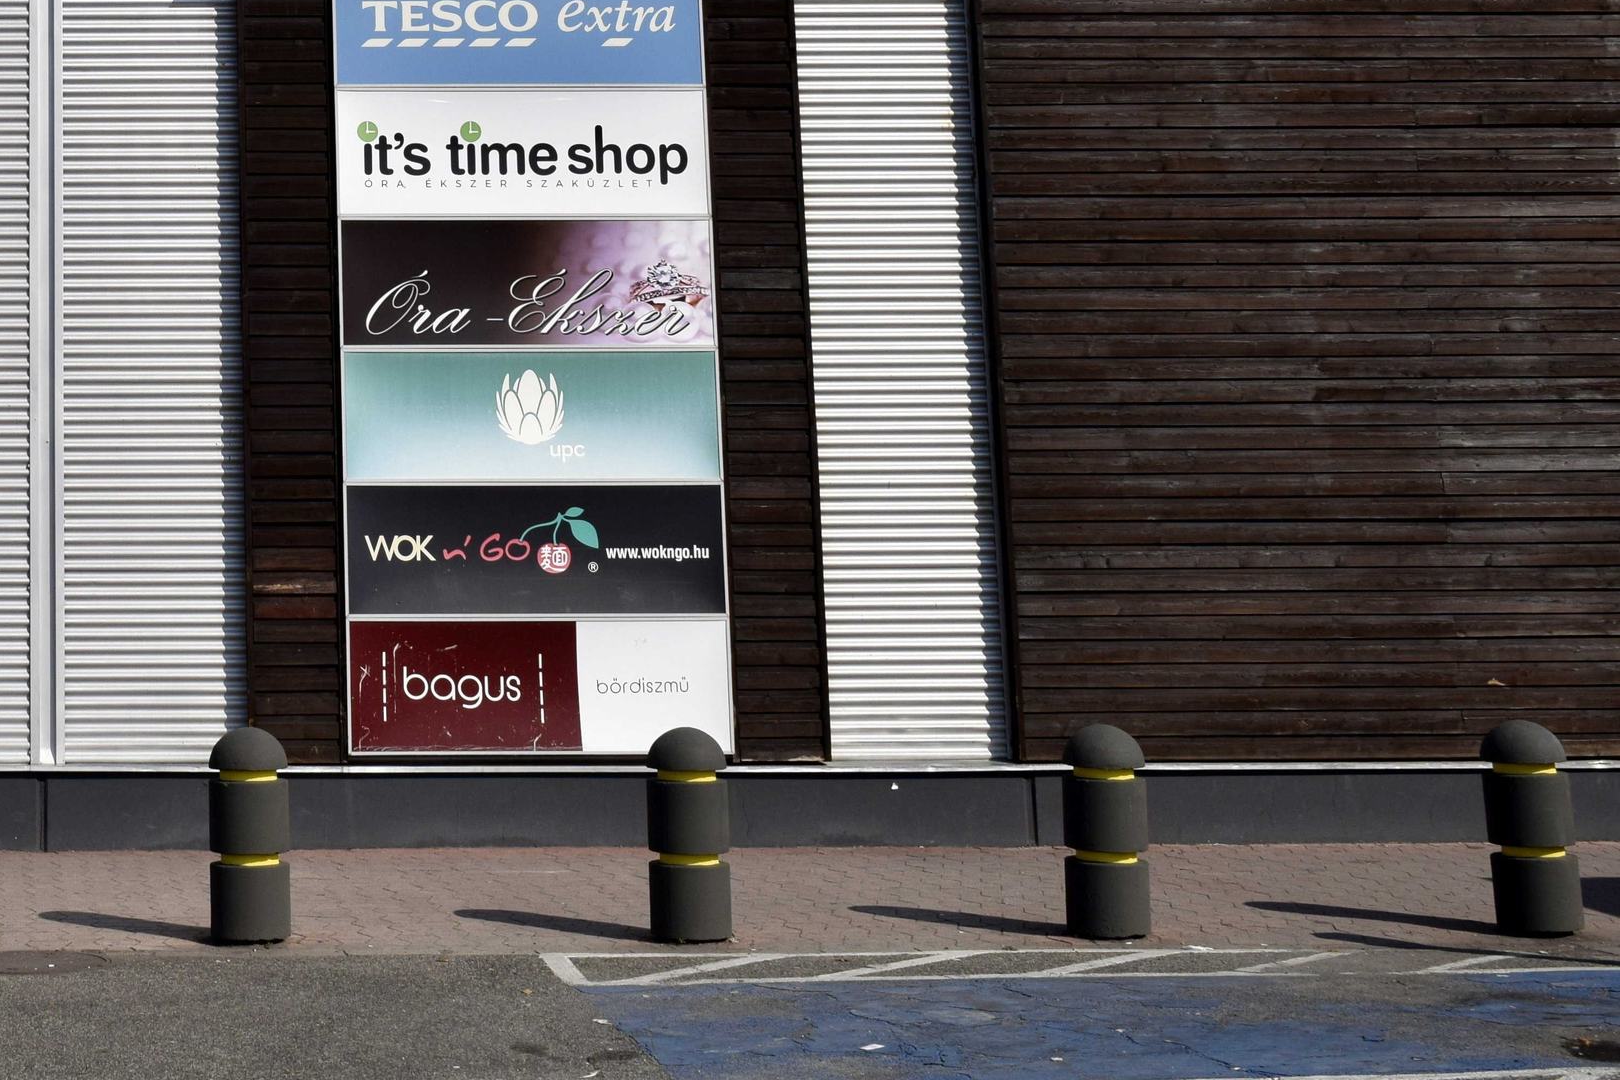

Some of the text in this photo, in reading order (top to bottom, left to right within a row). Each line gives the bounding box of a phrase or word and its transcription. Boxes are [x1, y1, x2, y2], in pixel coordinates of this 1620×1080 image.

[361, 0, 676, 33] TESCO extra
[357, 121, 688, 185] it's time shop
[425, 178, 507, 189] ÉKSZER
[526, 178, 653, 189] SZAKÜZLET
[365, 270, 471, 335] Óra
[549, 443, 585, 462] upc
[365, 535, 436, 561] WOK
[480, 533, 530, 561] GO
[606, 545, 710, 562] www.wokngo.hu
[403, 666, 521, 708] bagus
